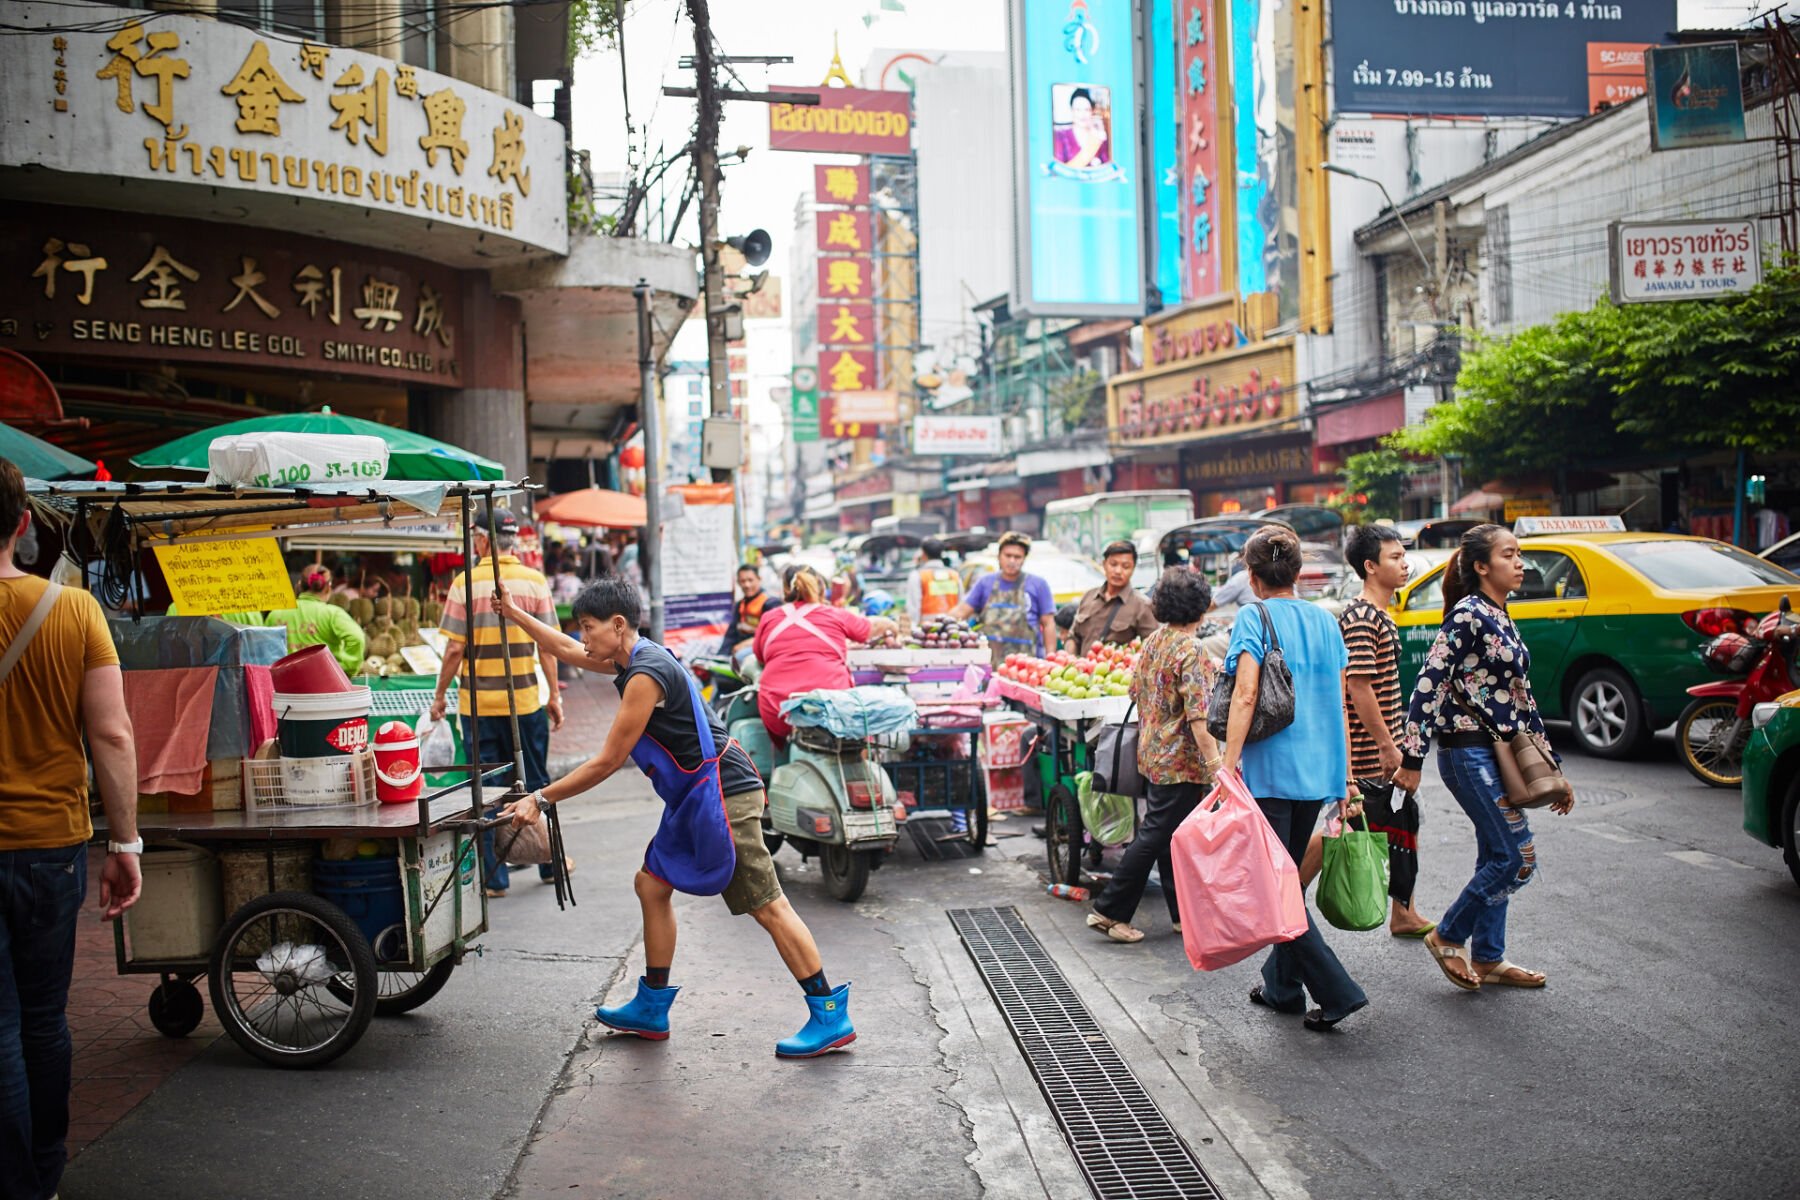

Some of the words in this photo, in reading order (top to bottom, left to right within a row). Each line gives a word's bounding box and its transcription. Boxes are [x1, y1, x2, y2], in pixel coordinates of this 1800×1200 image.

[1564, 2, 1576, 19] 4
[1459, 66, 1493, 88] ล้าน
[1627, 225, 1750, 257] เยาวราชทัวร์
[1644, 279, 1695, 292] JAWARAJ
[1700, 277, 1737, 289] TOURS
[73, 319, 142, 342] SENG
[151, 325, 214, 348] HENG
[221, 330, 261, 352] LEE
[324, 340, 376, 364] SMITH
[338, 724, 368, 747] DENZ
